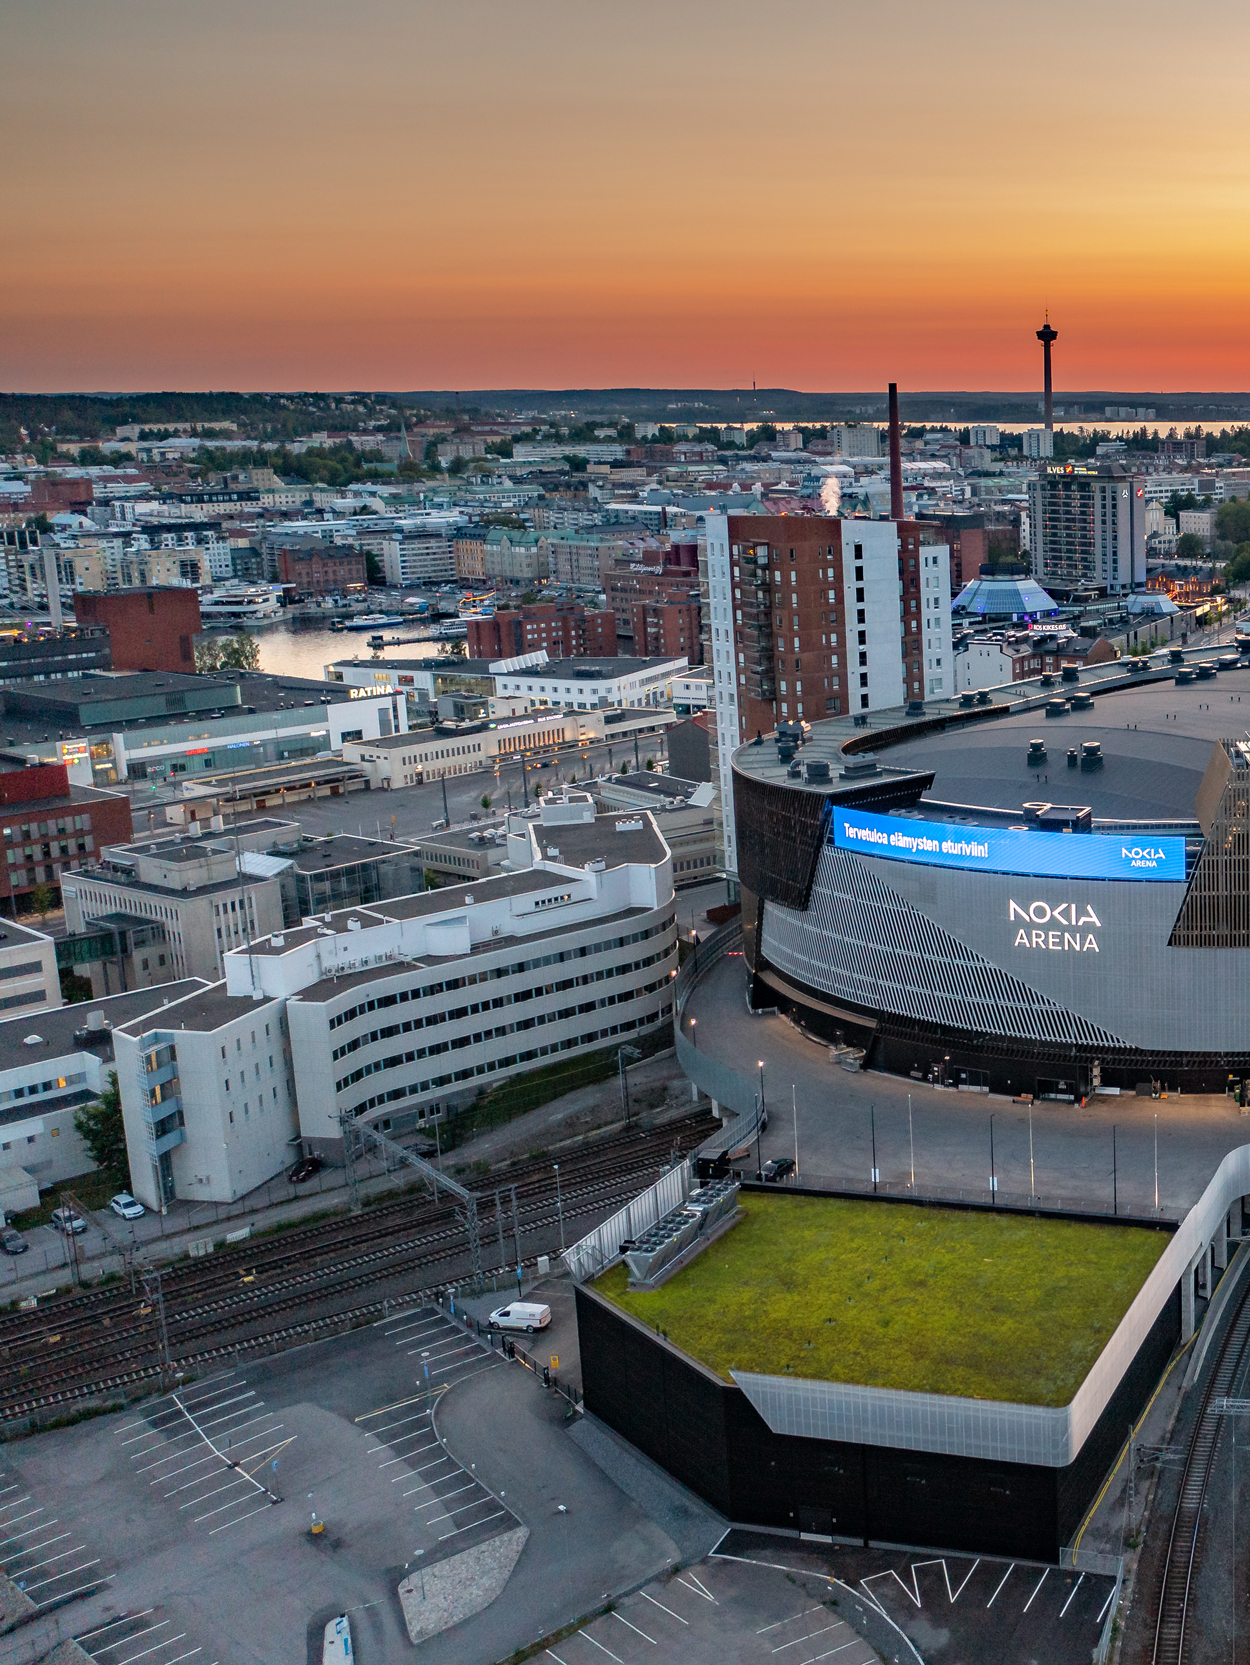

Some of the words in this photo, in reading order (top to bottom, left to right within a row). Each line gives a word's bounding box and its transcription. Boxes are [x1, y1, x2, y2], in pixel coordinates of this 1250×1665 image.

[1046, 466, 1064, 474] ILVES
[350, 684, 394, 698] RATINA
[844, 822, 888, 846] Tervetuloa
[890, 832, 939, 852] elämysten
[941, 838, 989, 858] eturiviin!
[1122, 847, 1166, 860] NOKIA
[1130, 859, 1158, 868] ARENA
[1009, 898, 1102, 927] NOKIA
[1014, 928, 1100, 952] ARENA
